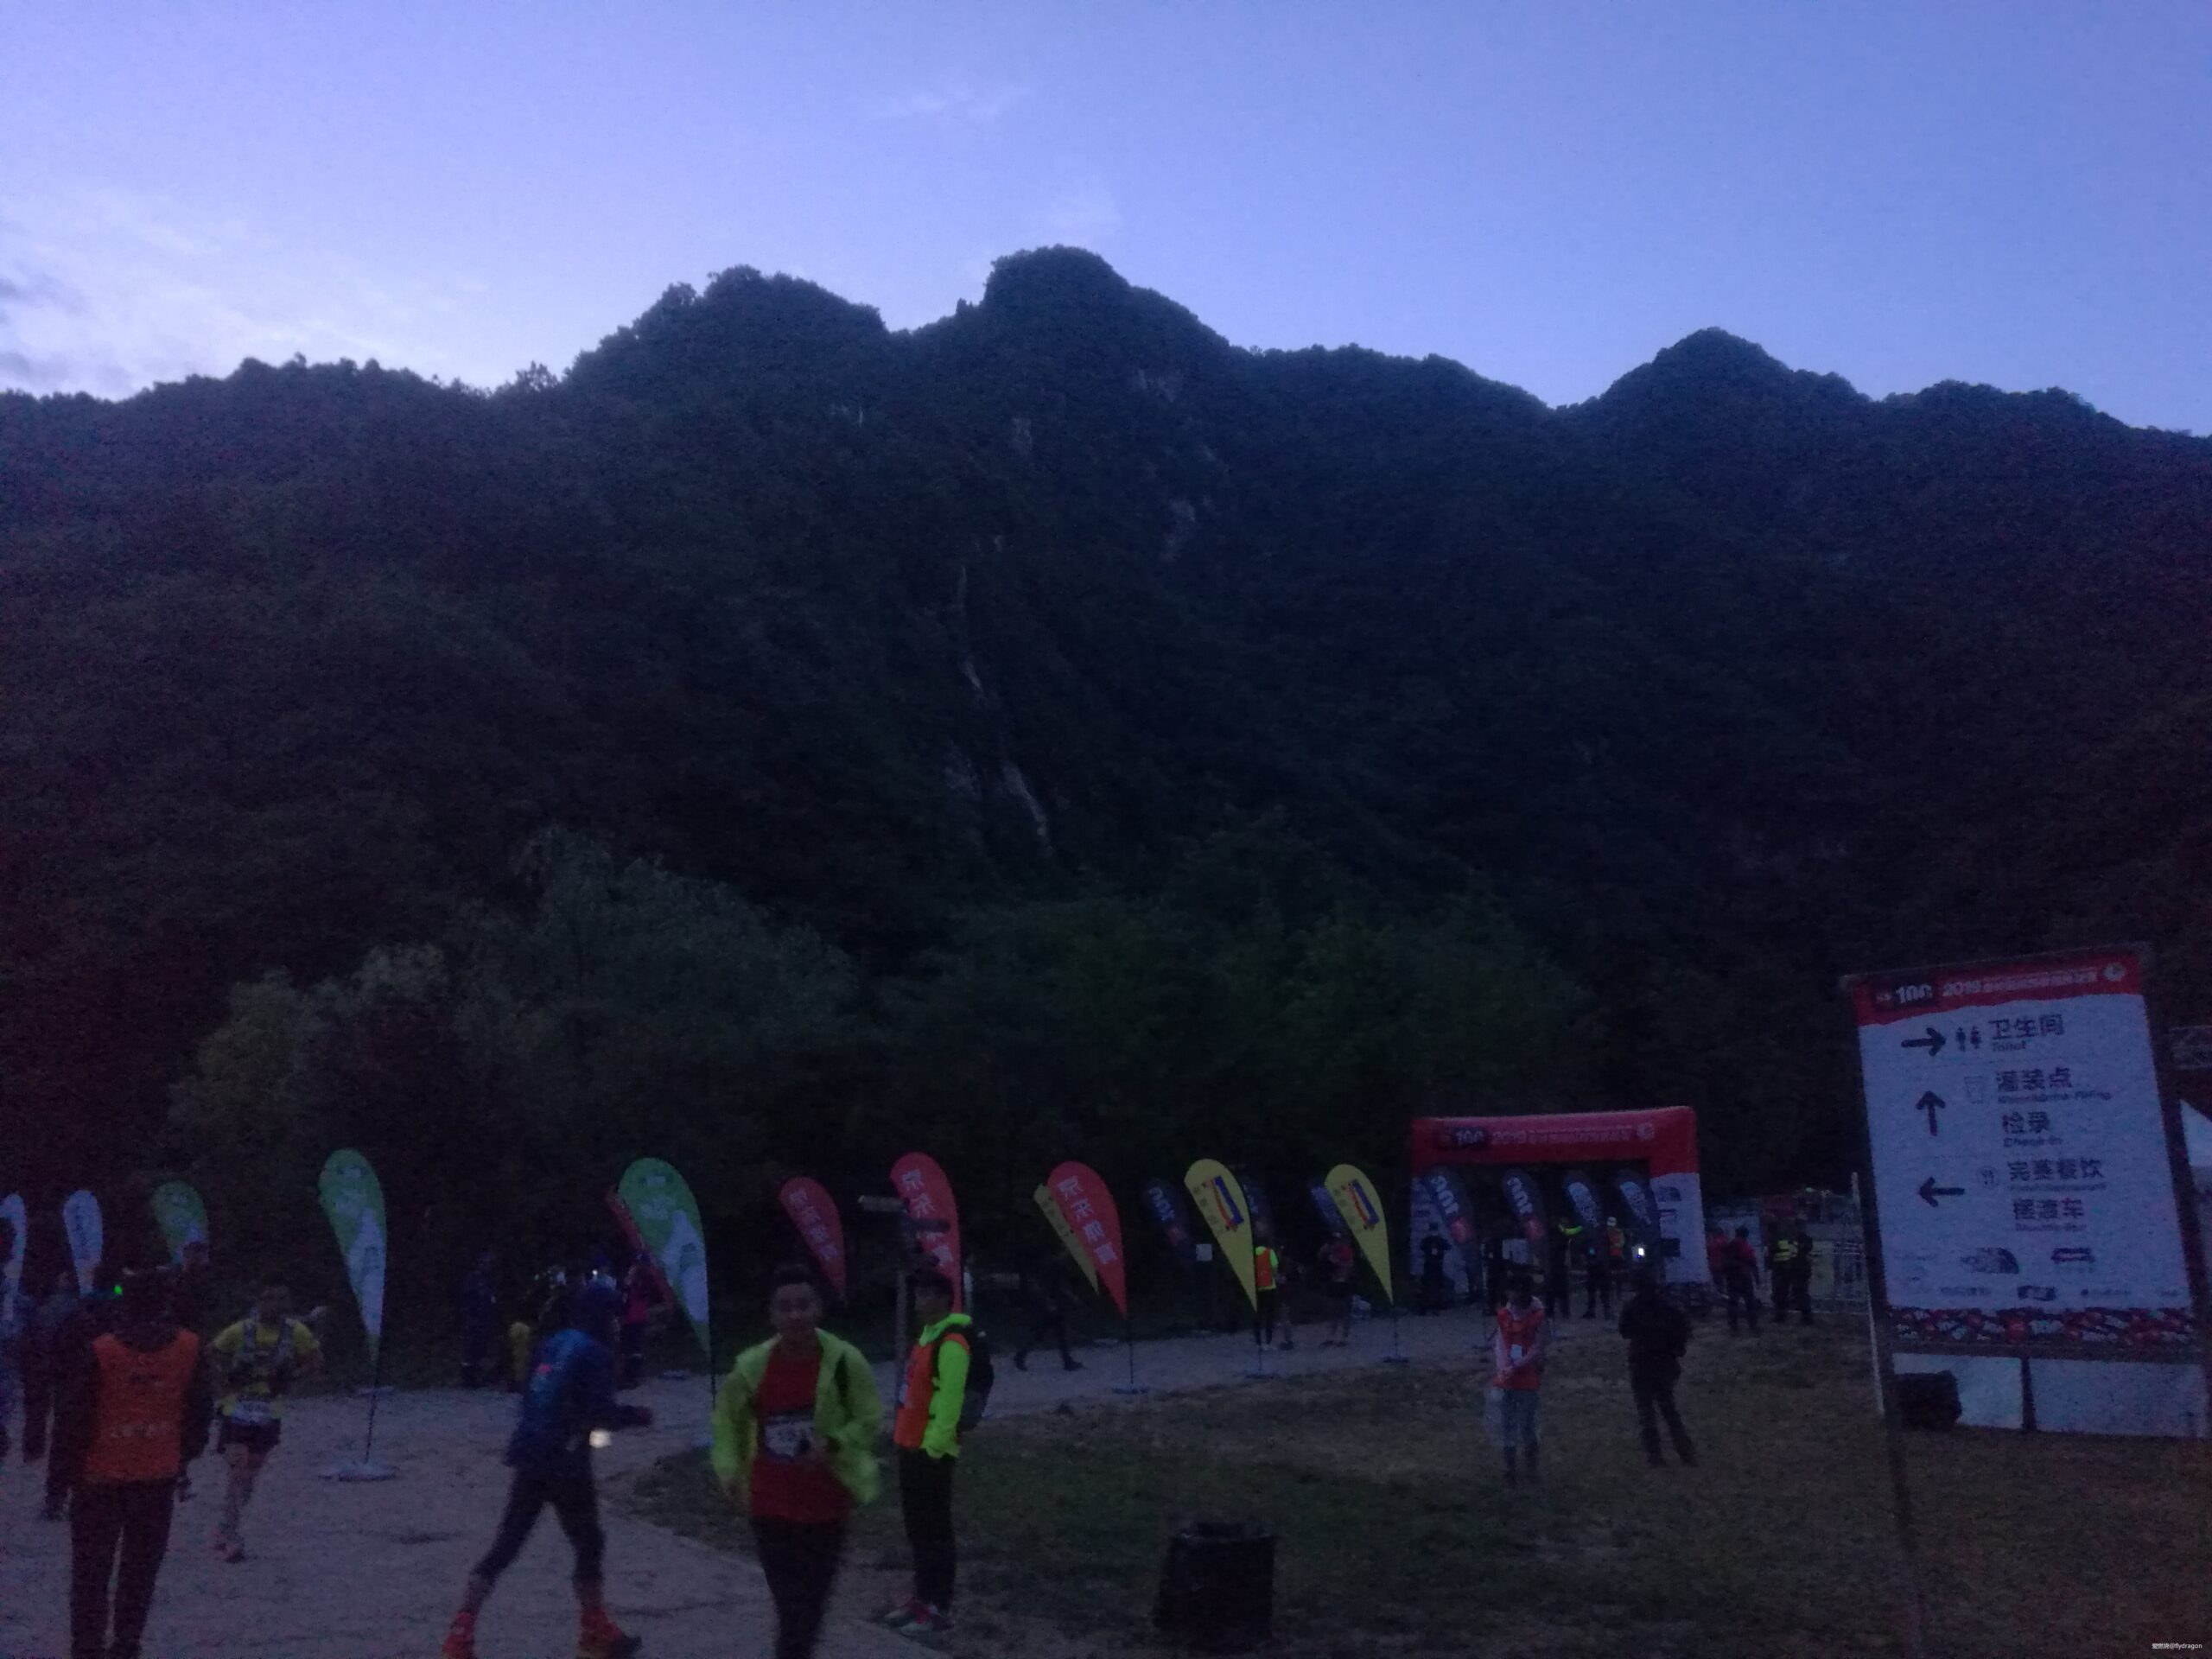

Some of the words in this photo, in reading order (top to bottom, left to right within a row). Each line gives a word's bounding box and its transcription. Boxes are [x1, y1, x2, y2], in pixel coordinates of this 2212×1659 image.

[1988, 1014, 2064, 1039] 卫生间
[2002, 1111, 2049, 1134] 检录
[2007, 1158, 2104, 1181] 完赛餐饮
[2013, 1198, 2085, 1220] 摆渡车
